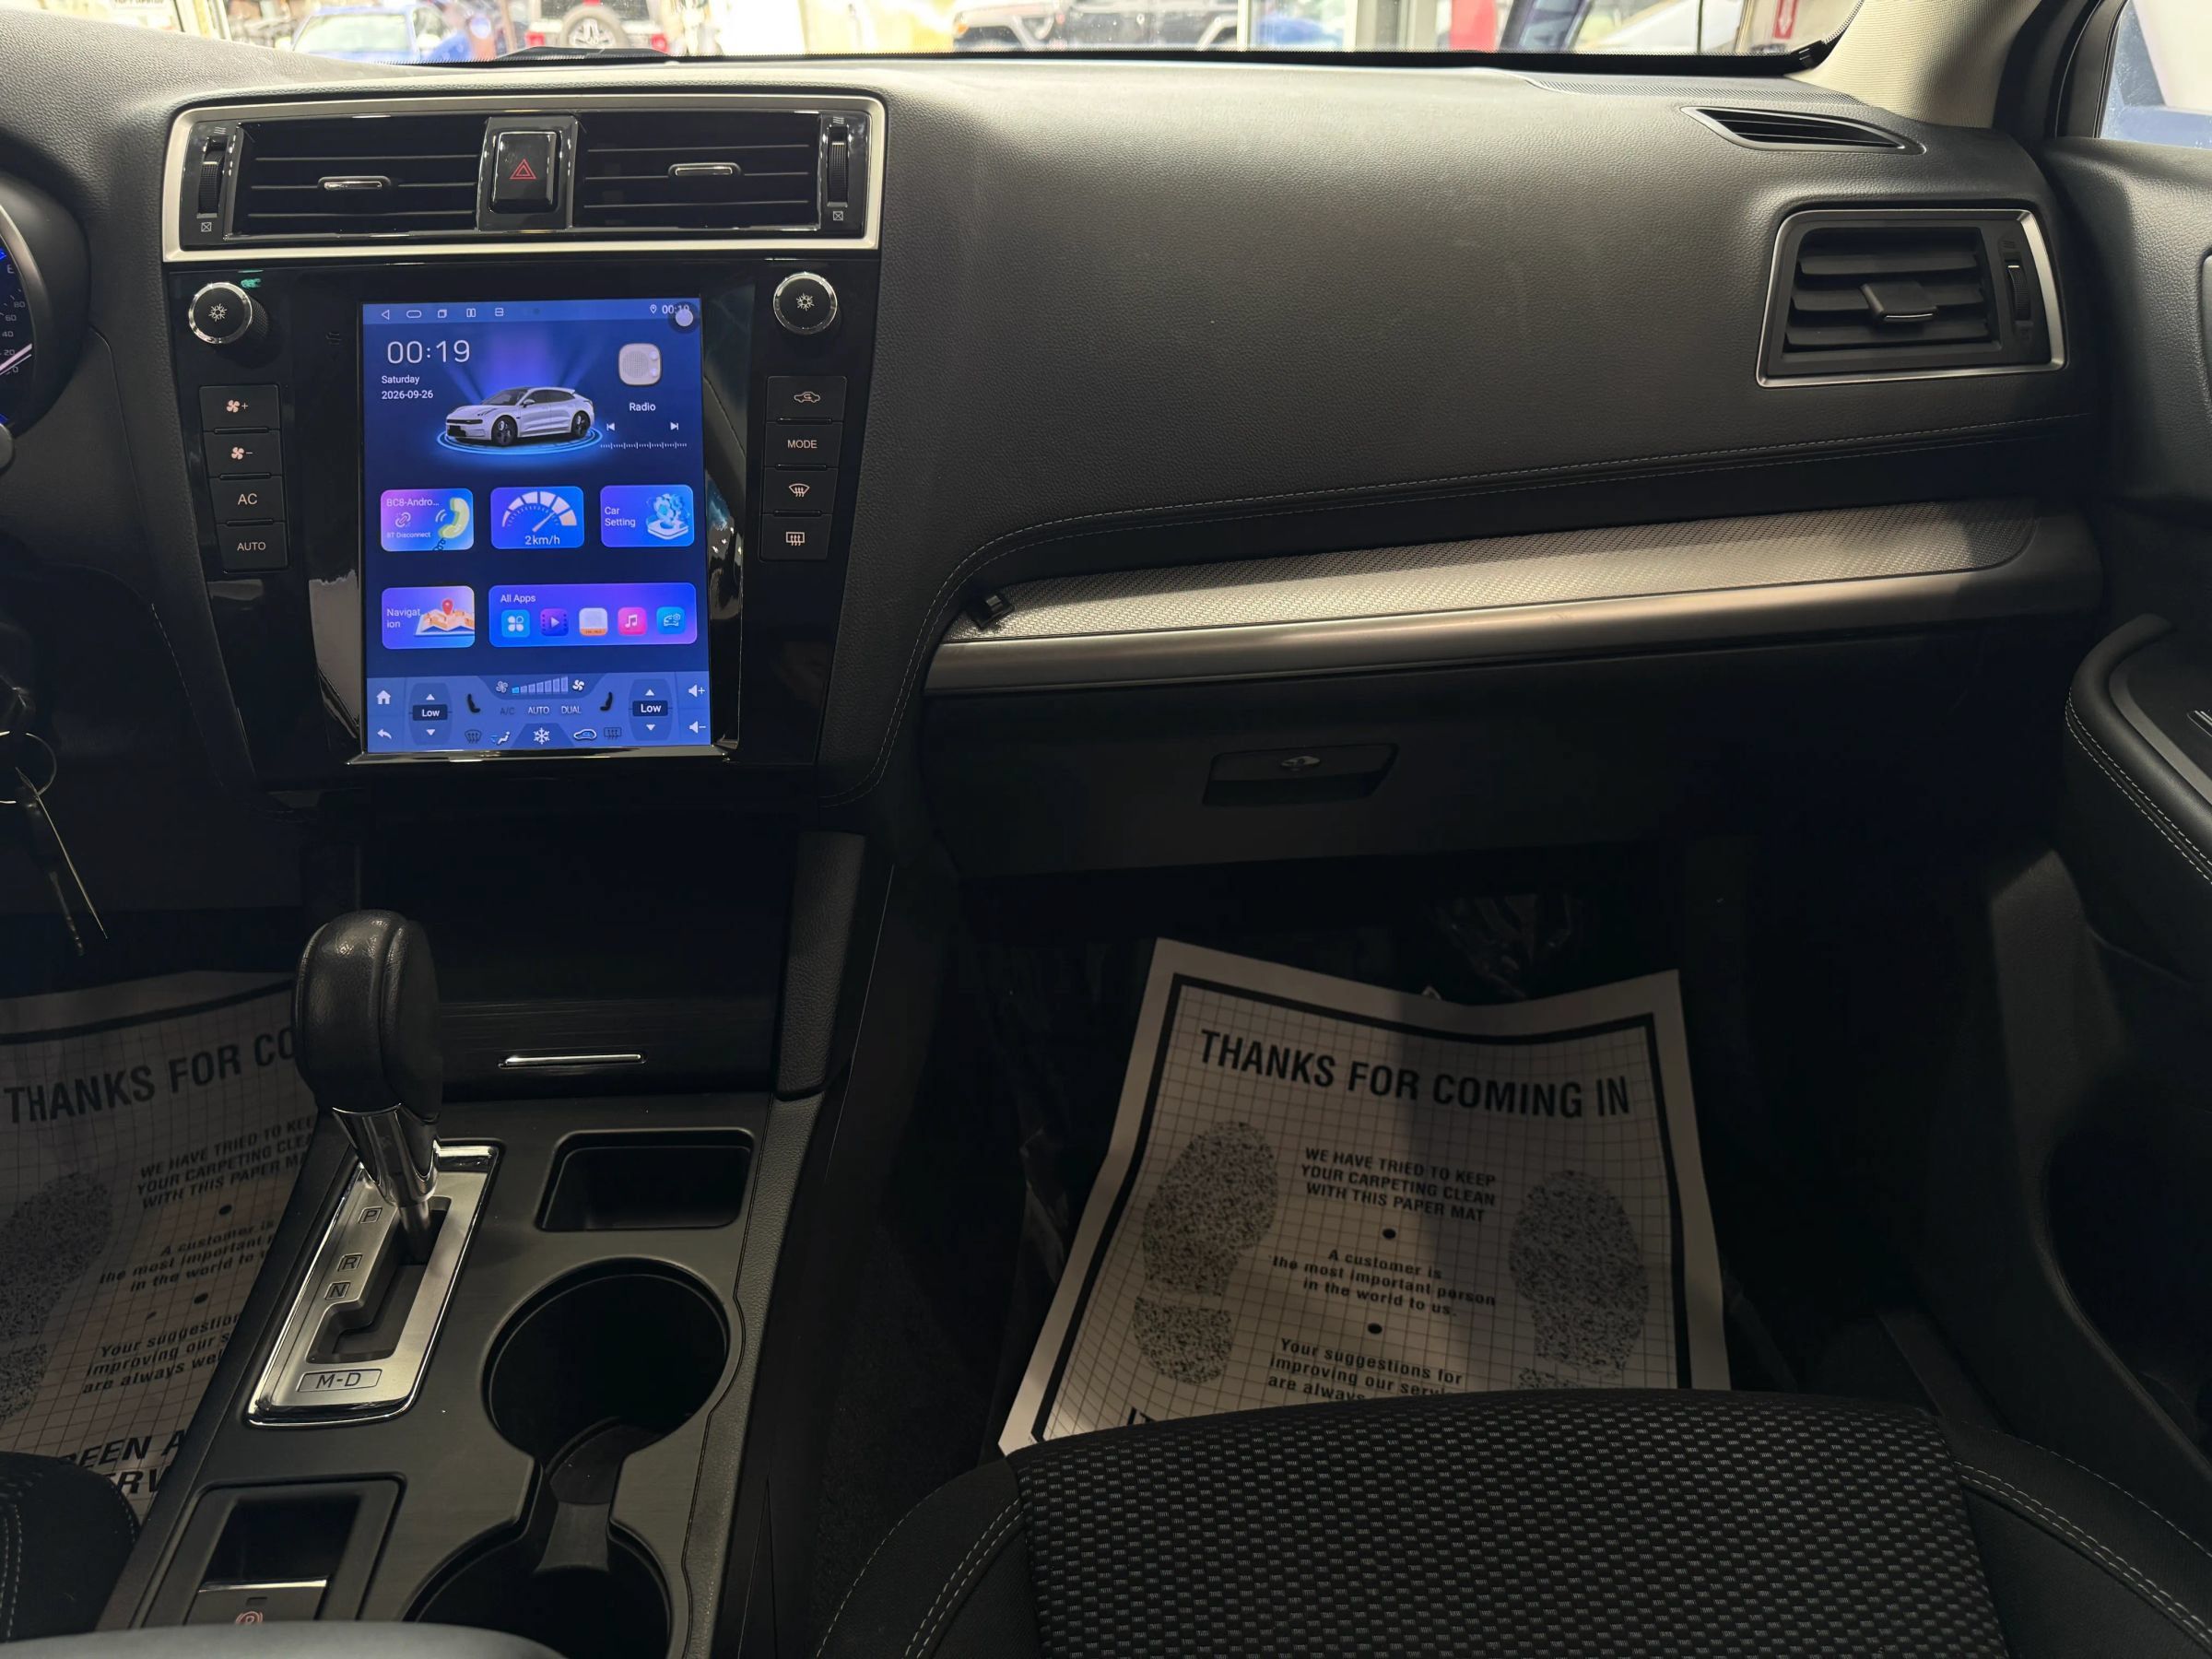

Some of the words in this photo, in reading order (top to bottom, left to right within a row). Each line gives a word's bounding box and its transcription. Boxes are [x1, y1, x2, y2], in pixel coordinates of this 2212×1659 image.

[387, 339, 470, 364] 00:19
[381, 374, 420, 385] Saturday
[381, 389, 434, 400] 2026-09-26
[629, 401, 656, 412] Radio
[787, 439, 818, 450] MODE
[238, 493, 257, 505] AC
[386, 497, 440, 508] BC8-Andro...
[605, 506, 620, 516] Car
[605, 517, 636, 529] Setting
[396, 531, 431, 539] Disconnect
[237, 541, 266, 552] AUTO
[500, 594, 512, 604] All
[513, 594, 536, 605] Apps
[386, 607, 421, 619] Navigat
[386, 619, 401, 629] ion
[421, 708, 441, 718] Low
[500, 706, 515, 716] A/C
[527, 706, 550, 715] AUTO
[560, 705, 582, 714] DUAL
[641, 703, 662, 714] Low
[1201, 1029, 1335, 1088] THANKS
[1348, 1061, 1419, 1100] FOR
[1433, 1073, 1583, 1119] COMING
[1596, 1076, 1630, 1116] IN
[4, 1065, 155, 1124] THANKS
[168, 1044, 241, 1093] FOR
[140, 1159, 163, 1179] WE
[169, 1147, 208, 1171] HAVE
[214, 1132, 258, 1157] TRIED
[264, 1124, 281, 1142] TO
[137, 1173, 180, 1195] YOUR
[185, 1144, 272, 1183] CARPETING
[1305, 1147, 1329, 1163] WE
[1333, 1150, 1373, 1170] HAVE
[1379, 1158, 1425, 1178] TRIED
[1430, 1164, 1451, 1181] TO
[1455, 1170, 1496, 1186] KEEP
[142, 1188, 184, 1211] WITH
[190, 1176, 224, 1199] THIS
[229, 1160, 281, 1188] PAPER
[1300, 1164, 1344, 1183] YOUR
[1348, 1171, 1438, 1198] CARPETING
[1442, 1185, 1496, 1206] CLEAN
[1306, 1182, 1347, 1201] WITH
[1353, 1189, 1388, 1207] THIS
[1393, 1196, 1445, 1217] PAPER
[1450, 1205, 1486, 1223] MAT
[363, 1210, 377, 1221] P
[159, 1245, 172, 1257] A
[178, 1225, 255, 1253] customer
[261, 1220, 275, 1232] is
[99, 1270, 126, 1285] the
[132, 1257, 175, 1277] most
[181, 1236, 263, 1266] important
[341, 1257, 358, 1269] R
[1327, 1250, 1339, 1262] A
[1345, 1253, 1423, 1277] customer
[1428, 1266, 1442, 1279] is
[130, 1279, 147, 1292] in
[153, 1272, 180, 1288] the
[186, 1259, 233, 1280] world
[238, 1253, 254, 1266] to
[1272, 1255, 1299, 1270] the
[1303, 1263, 1344, 1279] most
[1350, 1271, 1431, 1295] important
[1436, 1286, 1496, 1307] person
[330, 1285, 348, 1298] N
[1302, 1277, 1319, 1290] in
[1324, 1281, 1350, 1297] the
[1357, 1288, 1404, 1307] world
[1409, 1297, 1426, 1311] to
[1431, 1302, 1458, 1317] us.
[86, 1347, 180, 1379] improving
[185, 1335, 216, 1354] our
[100, 1339, 142, 1359] Your
[1281, 1337, 1320, 1358] Your
[1324, 1347, 1431, 1380] suggestions
[1437, 1368, 1463, 1385] for
[83, 1379, 113, 1394] are
[120, 1361, 185, 1388] always
[1269, 1356, 1359, 1387] improving
[1364, 1374, 1395, 1391] our
[1267, 1374, 1298, 1391] are
[60, 1435, 153, 1468] EEN
